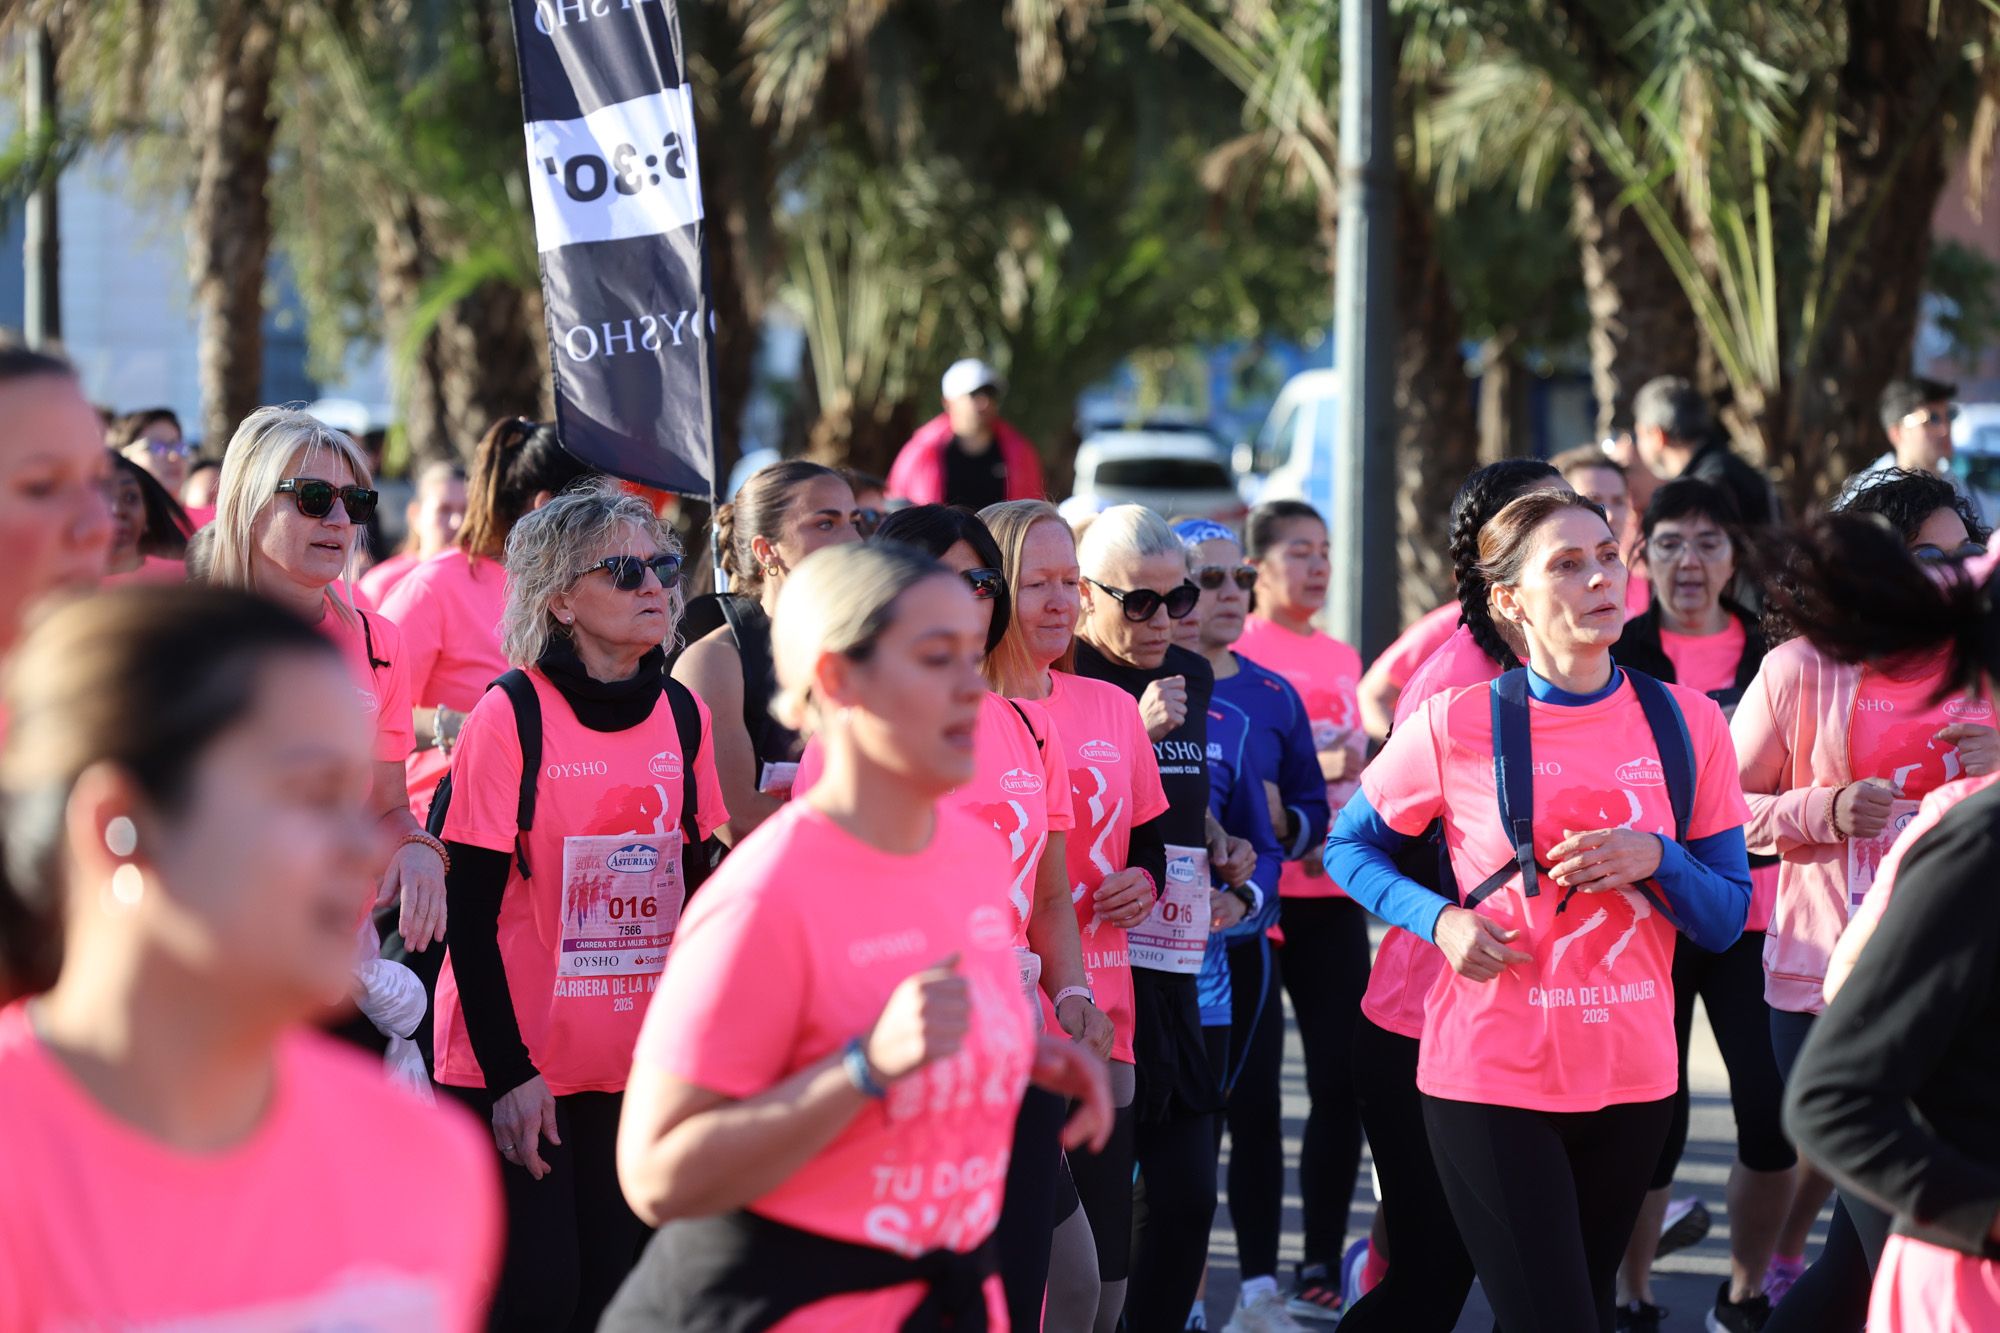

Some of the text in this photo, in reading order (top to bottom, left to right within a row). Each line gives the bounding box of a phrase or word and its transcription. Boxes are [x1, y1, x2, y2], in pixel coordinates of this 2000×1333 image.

[1858, 699, 1894, 712] SHO
[1153, 741, 1203, 762] YSHO
[547, 760, 608, 779] OYSHO
[1159, 766, 1184, 774] UNNING
[608, 896, 657, 920] 016
[1162, 902, 1193, 924] 016
[619, 925, 642, 936] 7566
[575, 941, 606, 949] CARRERA
[608, 940, 618, 948] DE
[628, 939, 648, 947] MUJER
[573, 955, 619, 968] OYSHO
[1088, 952, 1101, 969] LA
[555, 978, 609, 997] CARRERA
[613, 978, 625, 995] DE
[629, 975, 643, 993] LA
[1580, 987, 1600, 1006] DE
[1603, 986, 1620, 1004] LA
[1620, 980, 1655, 1002] MUJER
[614, 998, 634, 1012] 2025
[1583, 1008, 1609, 1024] 2025
